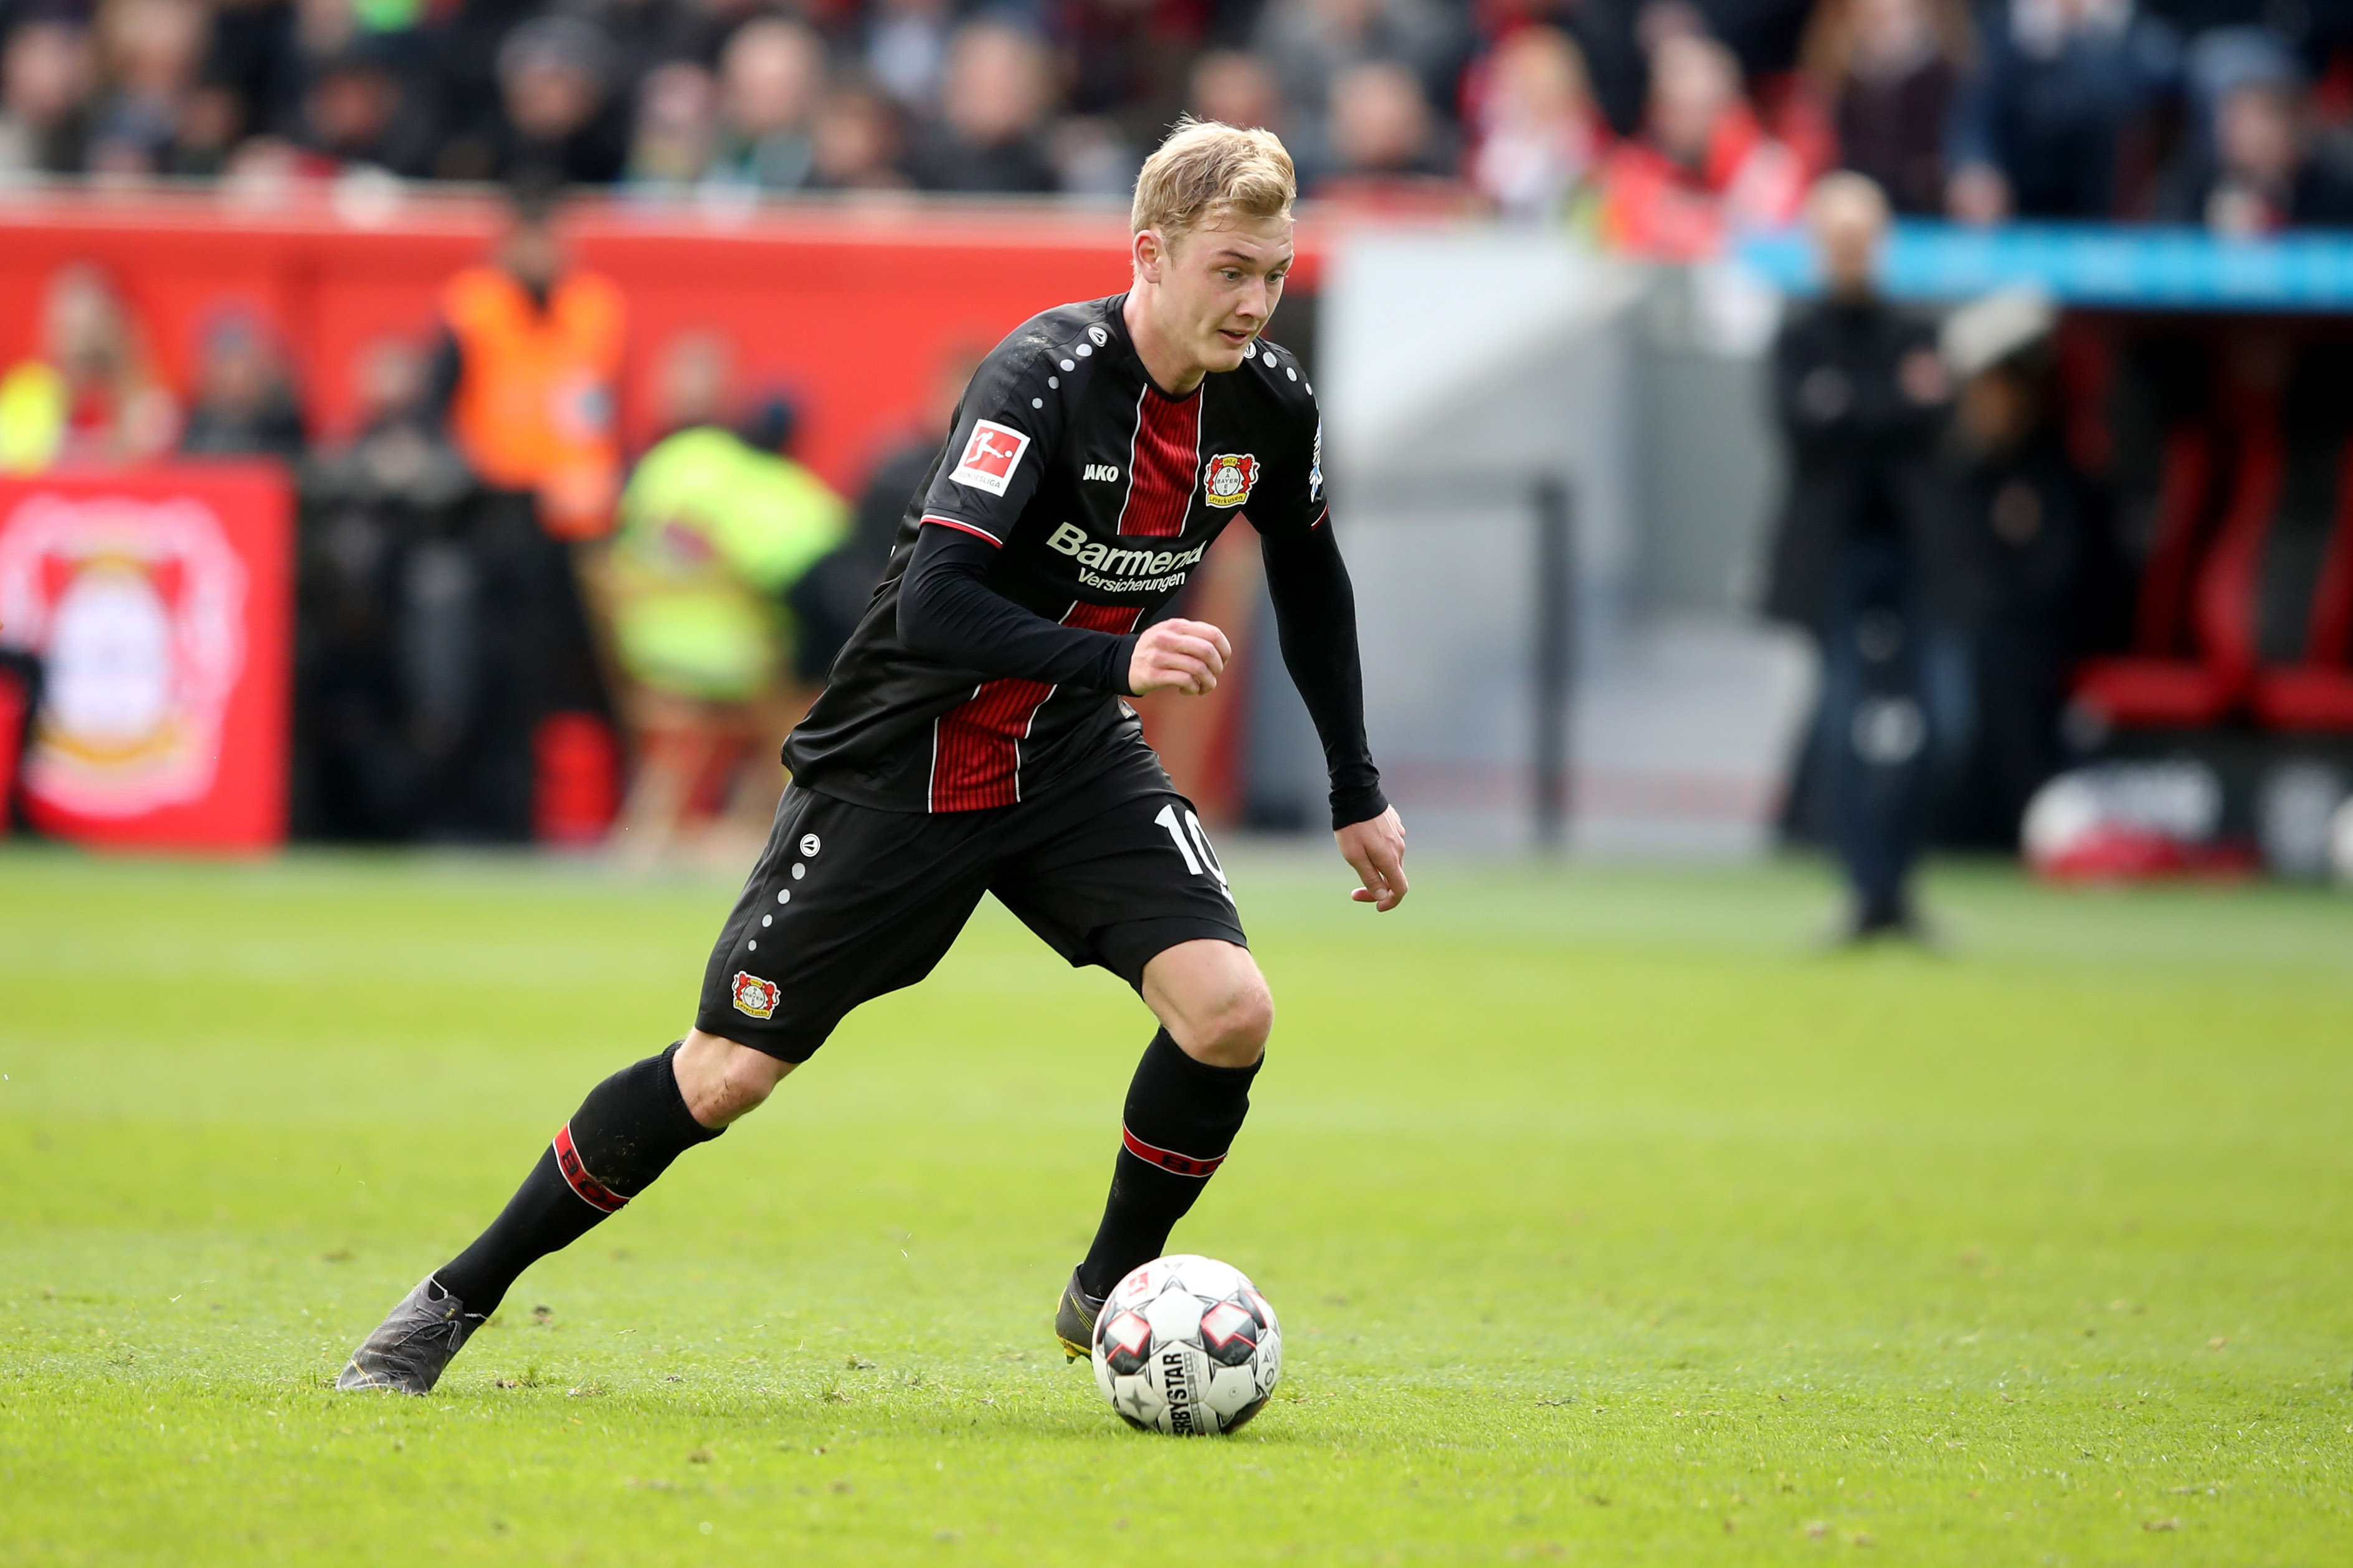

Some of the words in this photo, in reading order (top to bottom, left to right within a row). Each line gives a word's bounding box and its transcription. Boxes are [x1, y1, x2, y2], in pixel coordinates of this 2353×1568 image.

[958, 471, 1001, 488] BUNDESLIGA
[1083, 464, 1119, 482] JAKO
[1209, 496, 1242, 504] Leverkusen
[1078, 567, 1186, 592] Versicherungen
[1154, 804, 1227, 886] 10
[1162, 1353, 1194, 1435] ERBYSTAR
